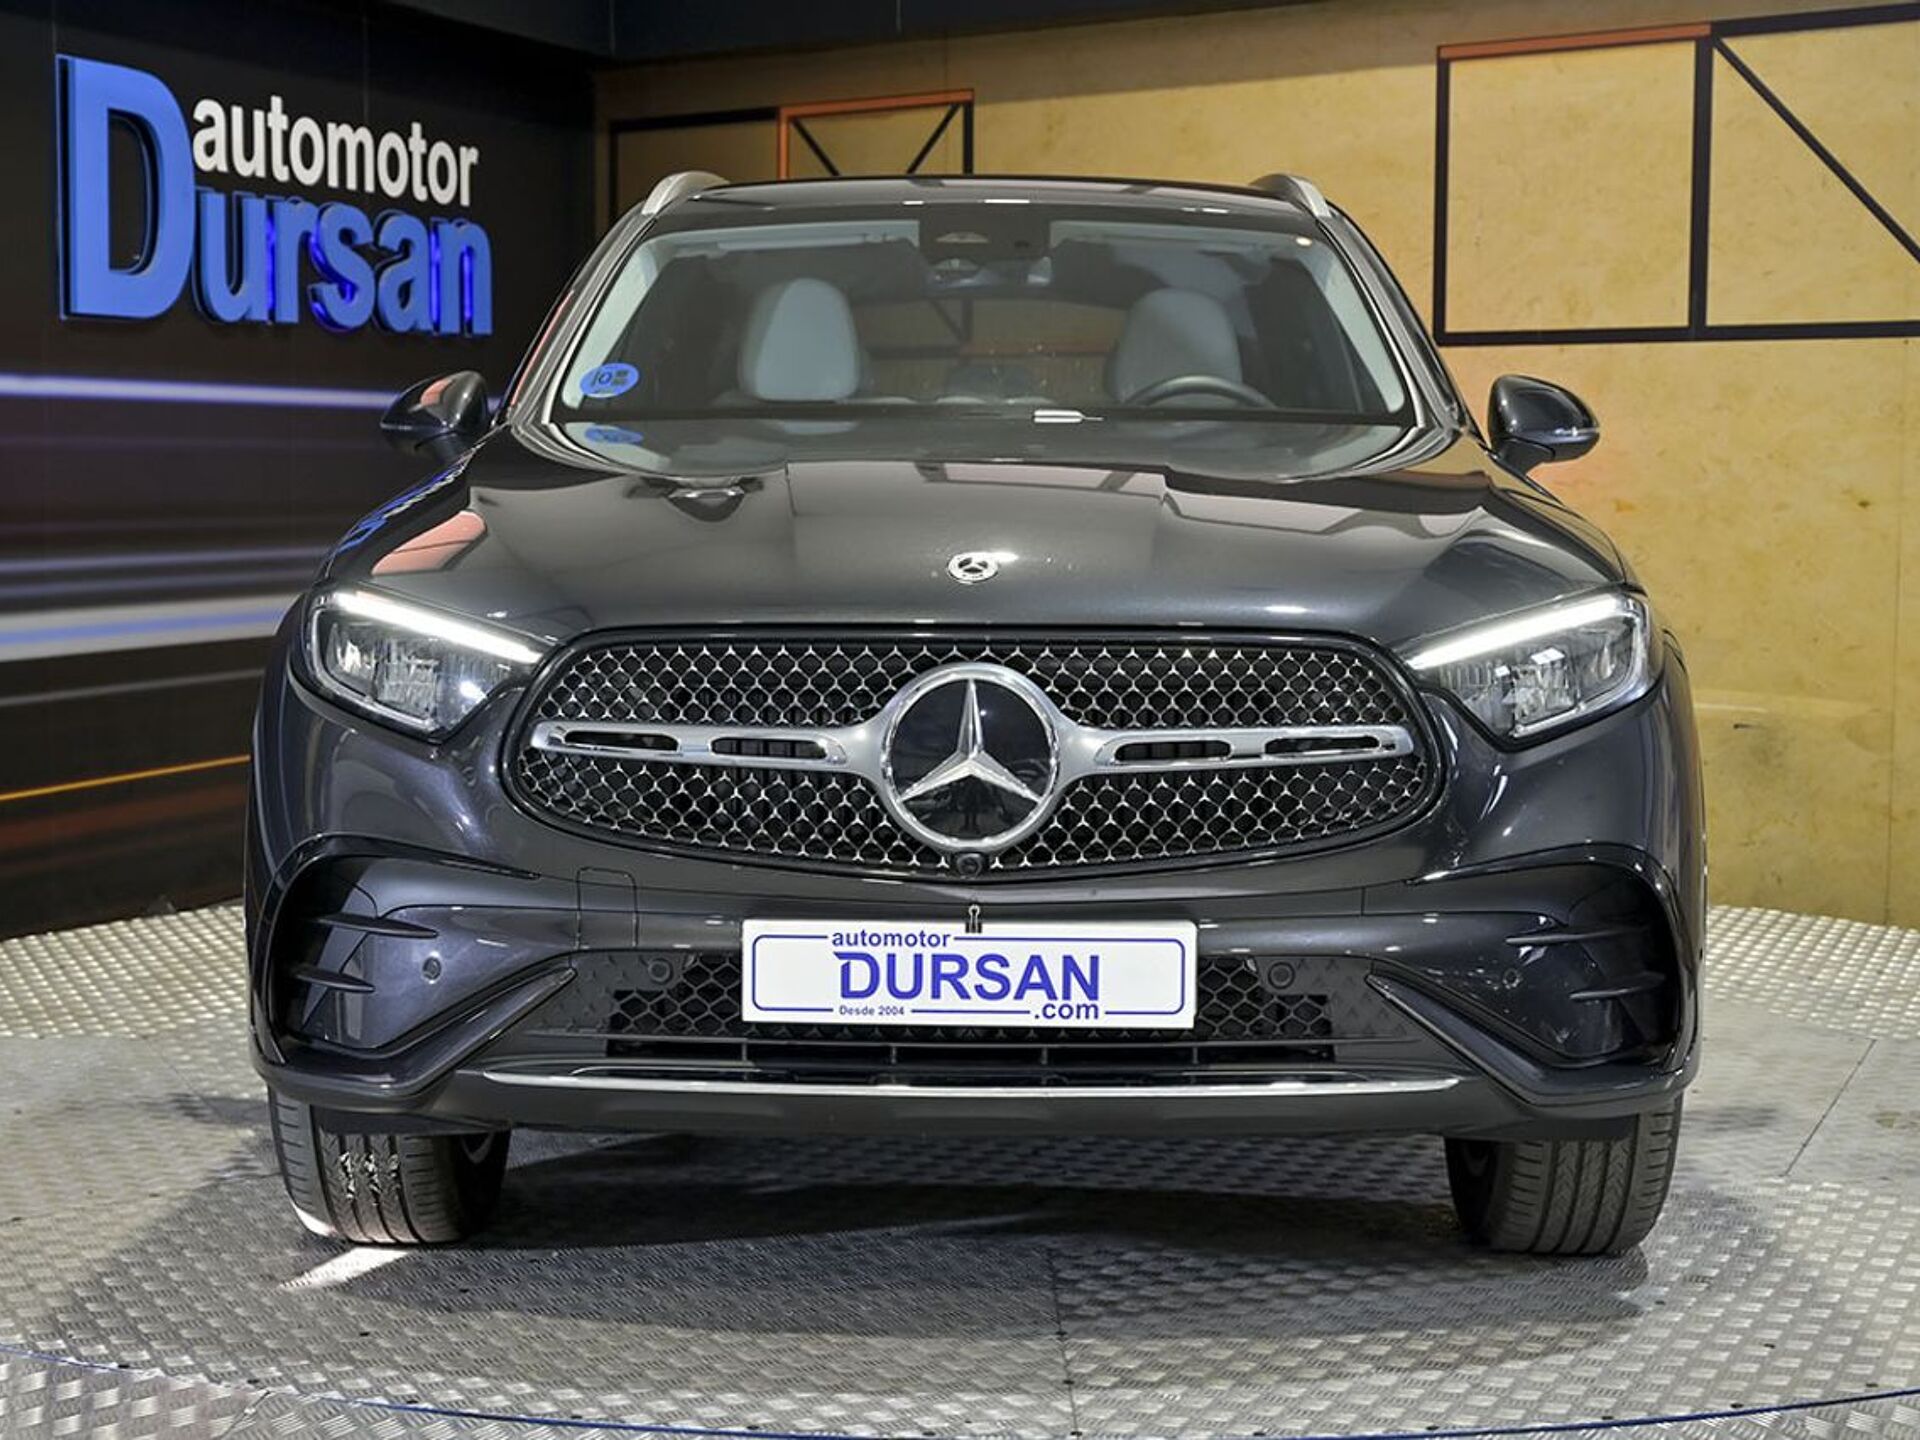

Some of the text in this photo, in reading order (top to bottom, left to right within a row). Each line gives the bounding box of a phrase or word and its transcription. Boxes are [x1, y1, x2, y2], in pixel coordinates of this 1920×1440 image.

[192, 95, 479, 207] automotor
[55, 53, 494, 337] Dursan
[832, 929, 951, 947] automotor
[833, 951, 1099, 1001] DURSAN
[839, 1004, 905, 1016] Desde 2004
[1034, 1002, 1099, 1020] .com
